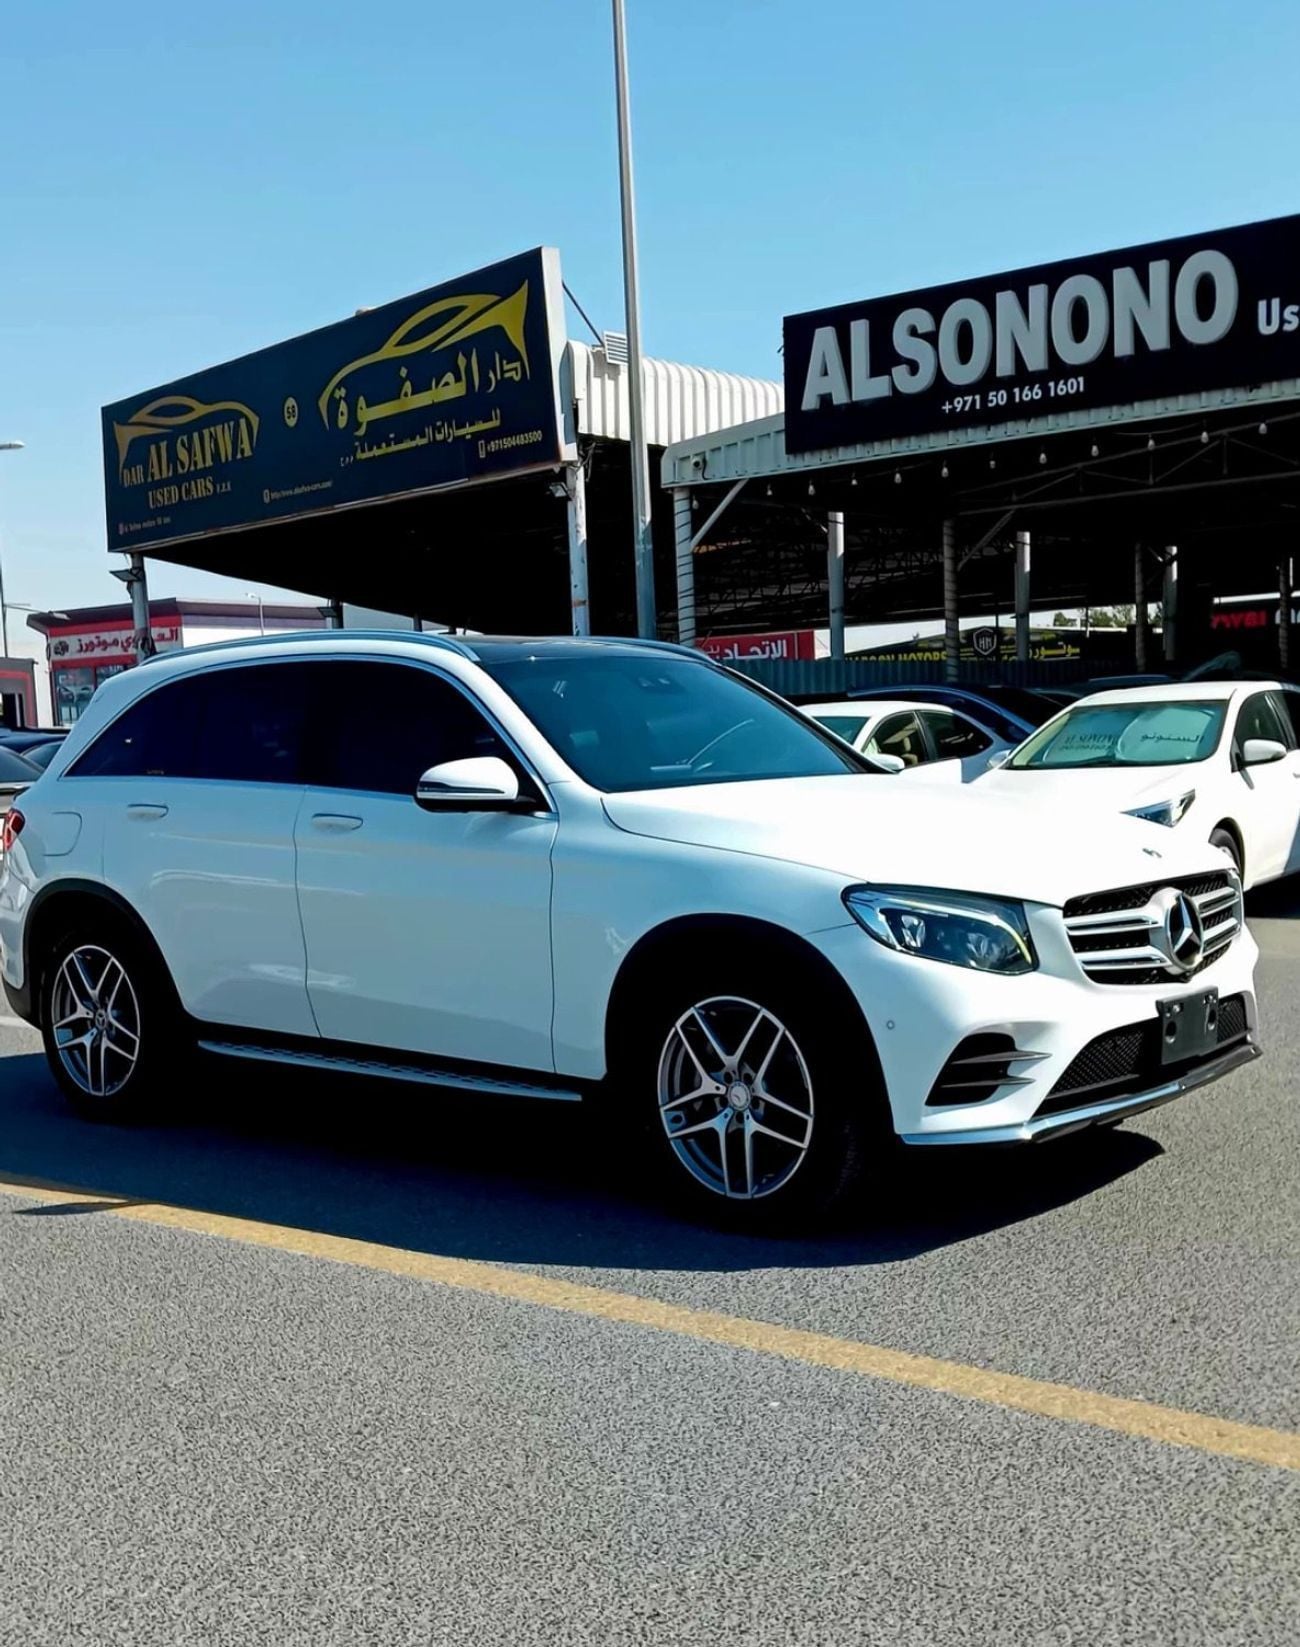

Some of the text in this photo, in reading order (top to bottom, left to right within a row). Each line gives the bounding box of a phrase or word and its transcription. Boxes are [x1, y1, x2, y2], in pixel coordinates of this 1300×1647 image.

[801, 249, 1239, 411] ALSONONO
[1257, 297, 1300, 336] Us
[333, 347, 522, 436] دار الصفوة
[942, 376, 1086, 415] +971 50 166 1601
[354, 424, 433, 460] المستعملة
[435, 407, 501, 443] للسيارات
[122, 417, 253, 488] DAR AL SAFWA
[148, 482, 179, 510] USED
[181, 476, 214, 501] CARS
